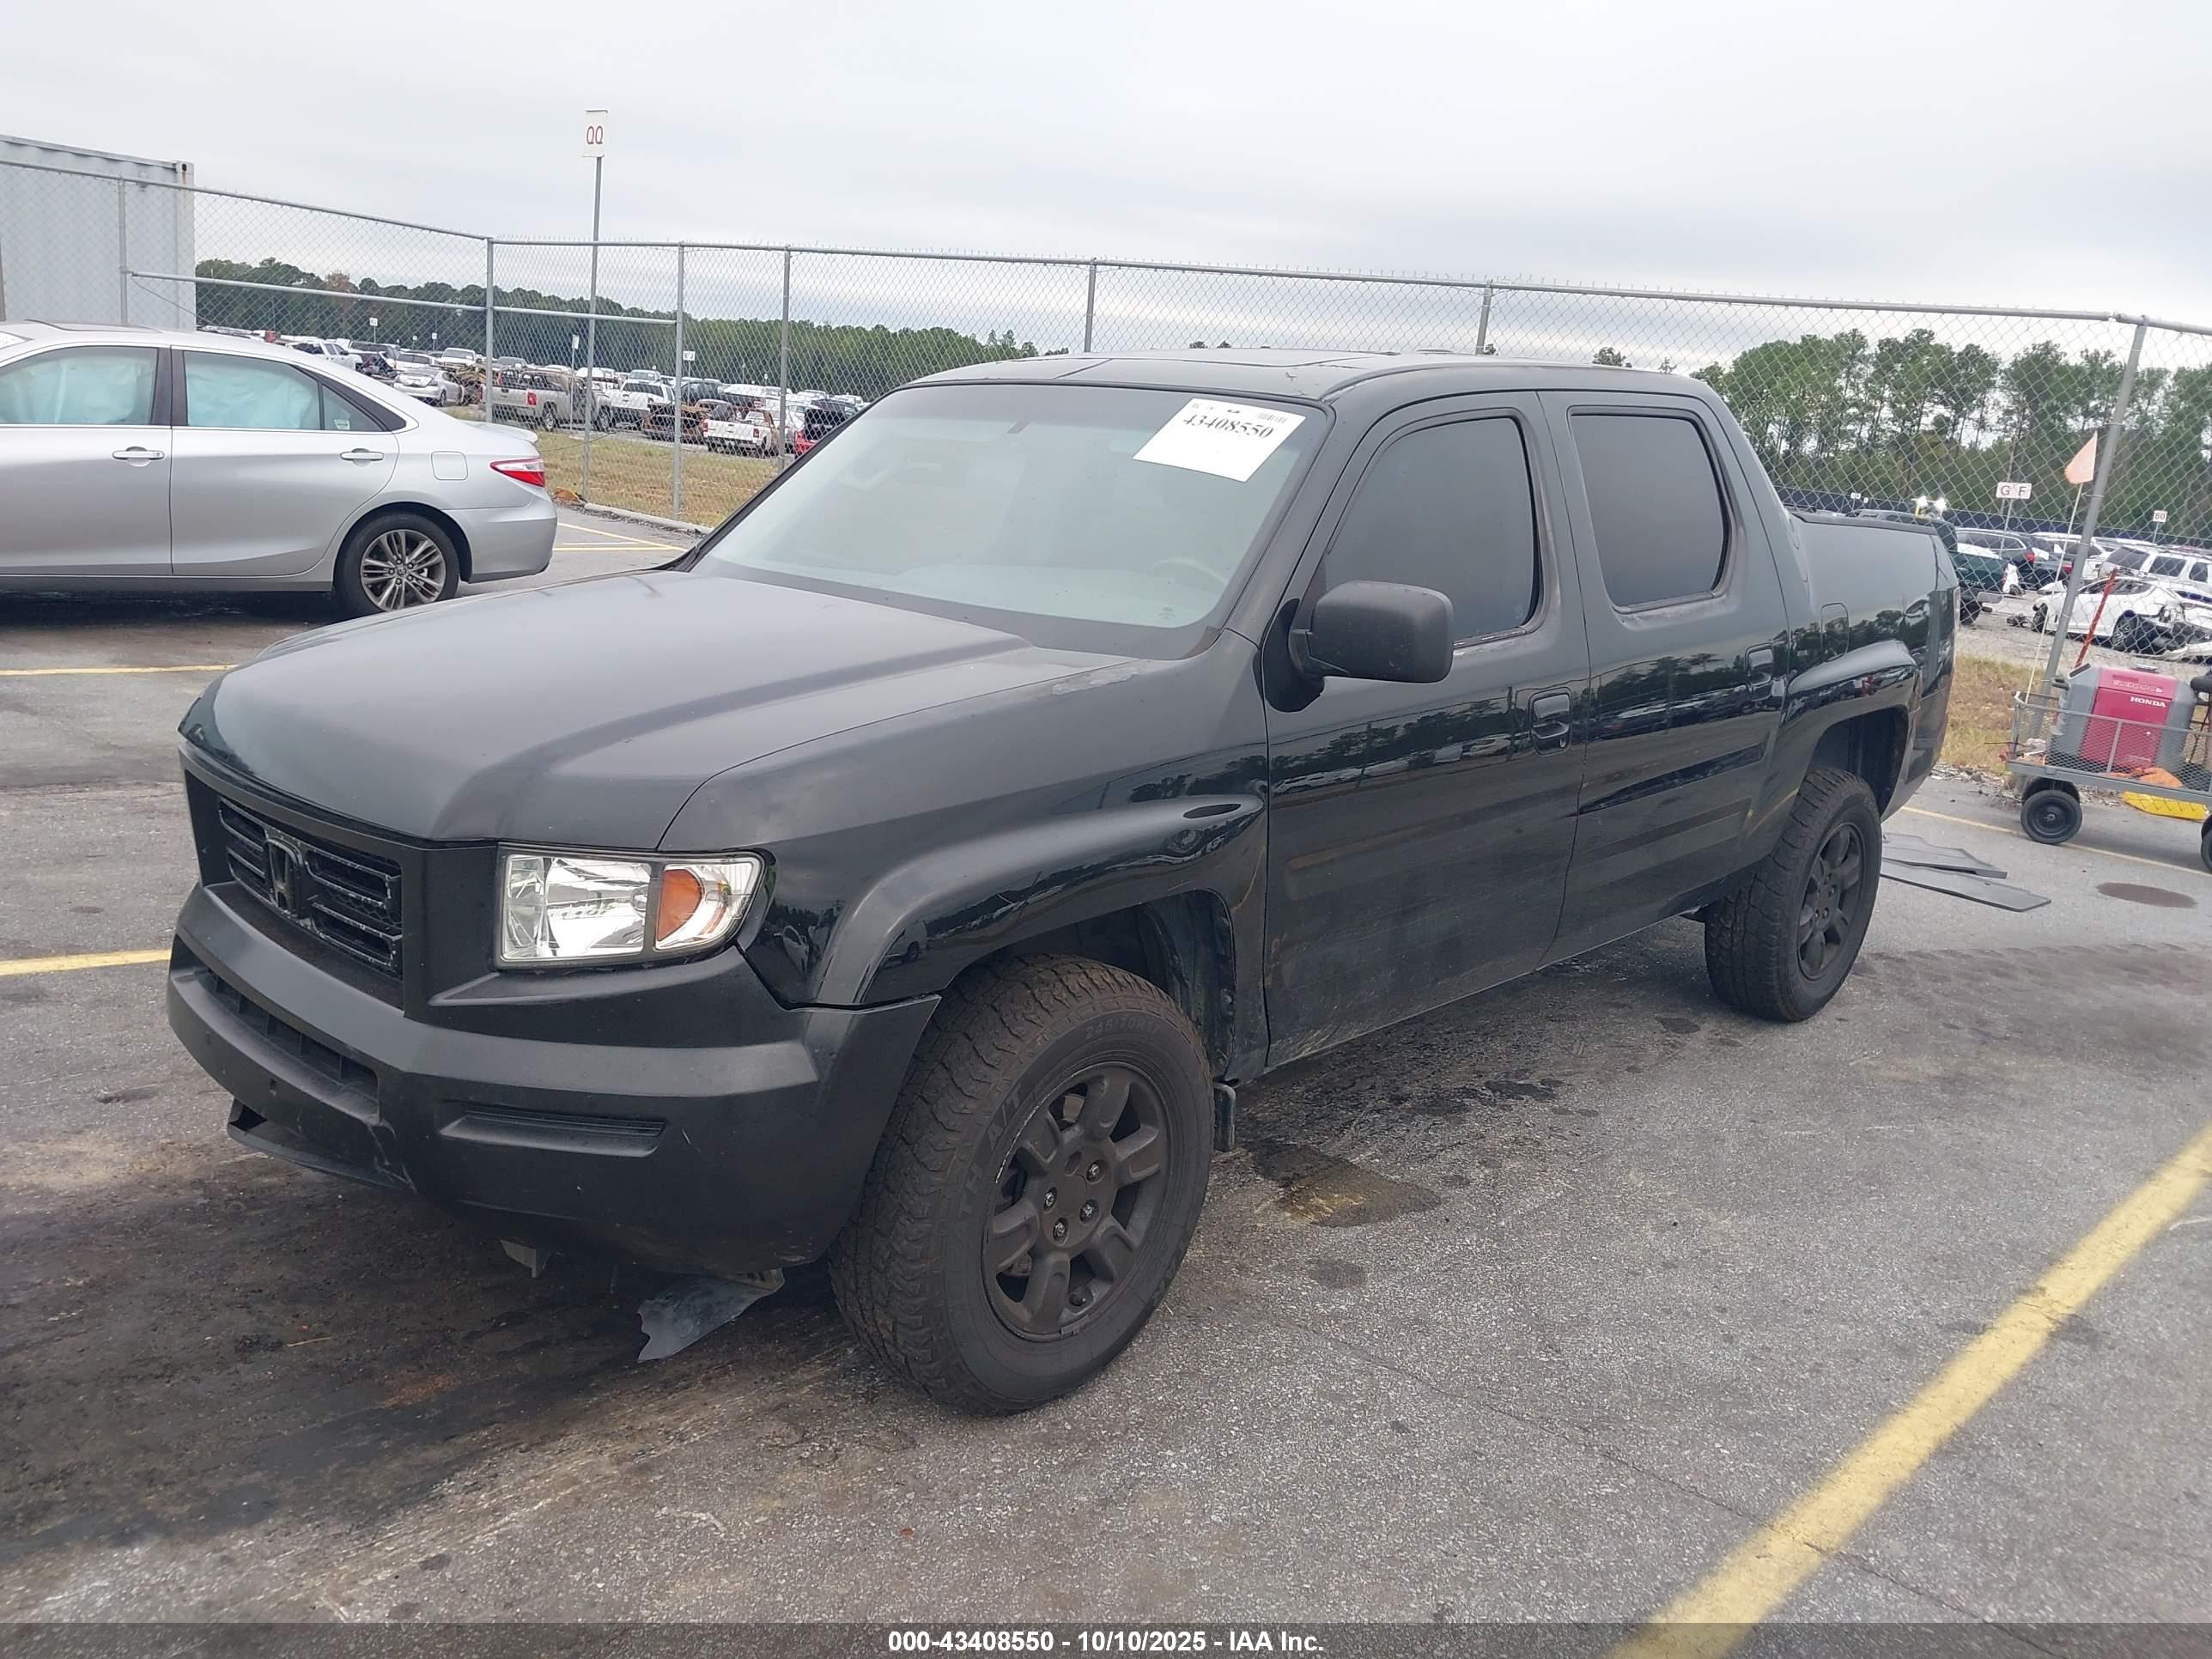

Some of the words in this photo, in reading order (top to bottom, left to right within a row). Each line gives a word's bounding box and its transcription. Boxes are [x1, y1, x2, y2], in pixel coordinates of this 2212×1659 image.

[586, 125, 604, 145] QQ
[1183, 414, 1273, 438] 43408550
[2000, 485, 2011, 495] G
[2018, 486, 2027, 496] F
[2130, 696, 2167, 708] HONDA
